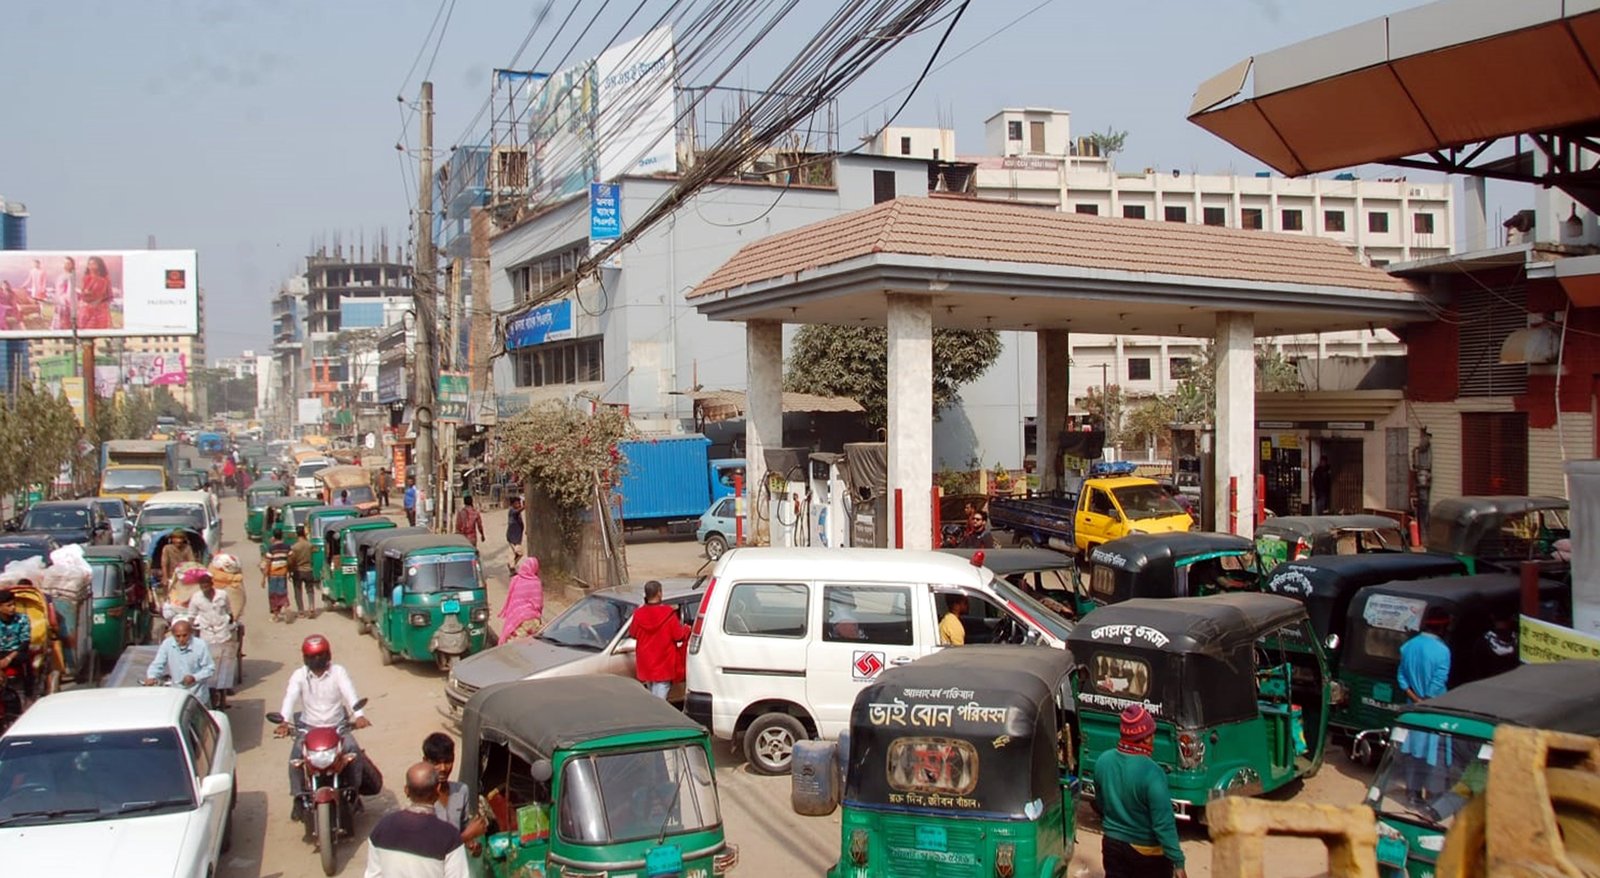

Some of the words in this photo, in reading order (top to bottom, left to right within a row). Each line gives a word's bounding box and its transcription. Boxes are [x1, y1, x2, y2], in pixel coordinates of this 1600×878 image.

[1135, 626, 1170, 648] ভরসা
[868, 697, 908, 726] ভাই
[910, 702, 954, 727] বোন
[957, 702, 1007, 724] পরিবহন
[928, 792, 954, 807] জীবন
